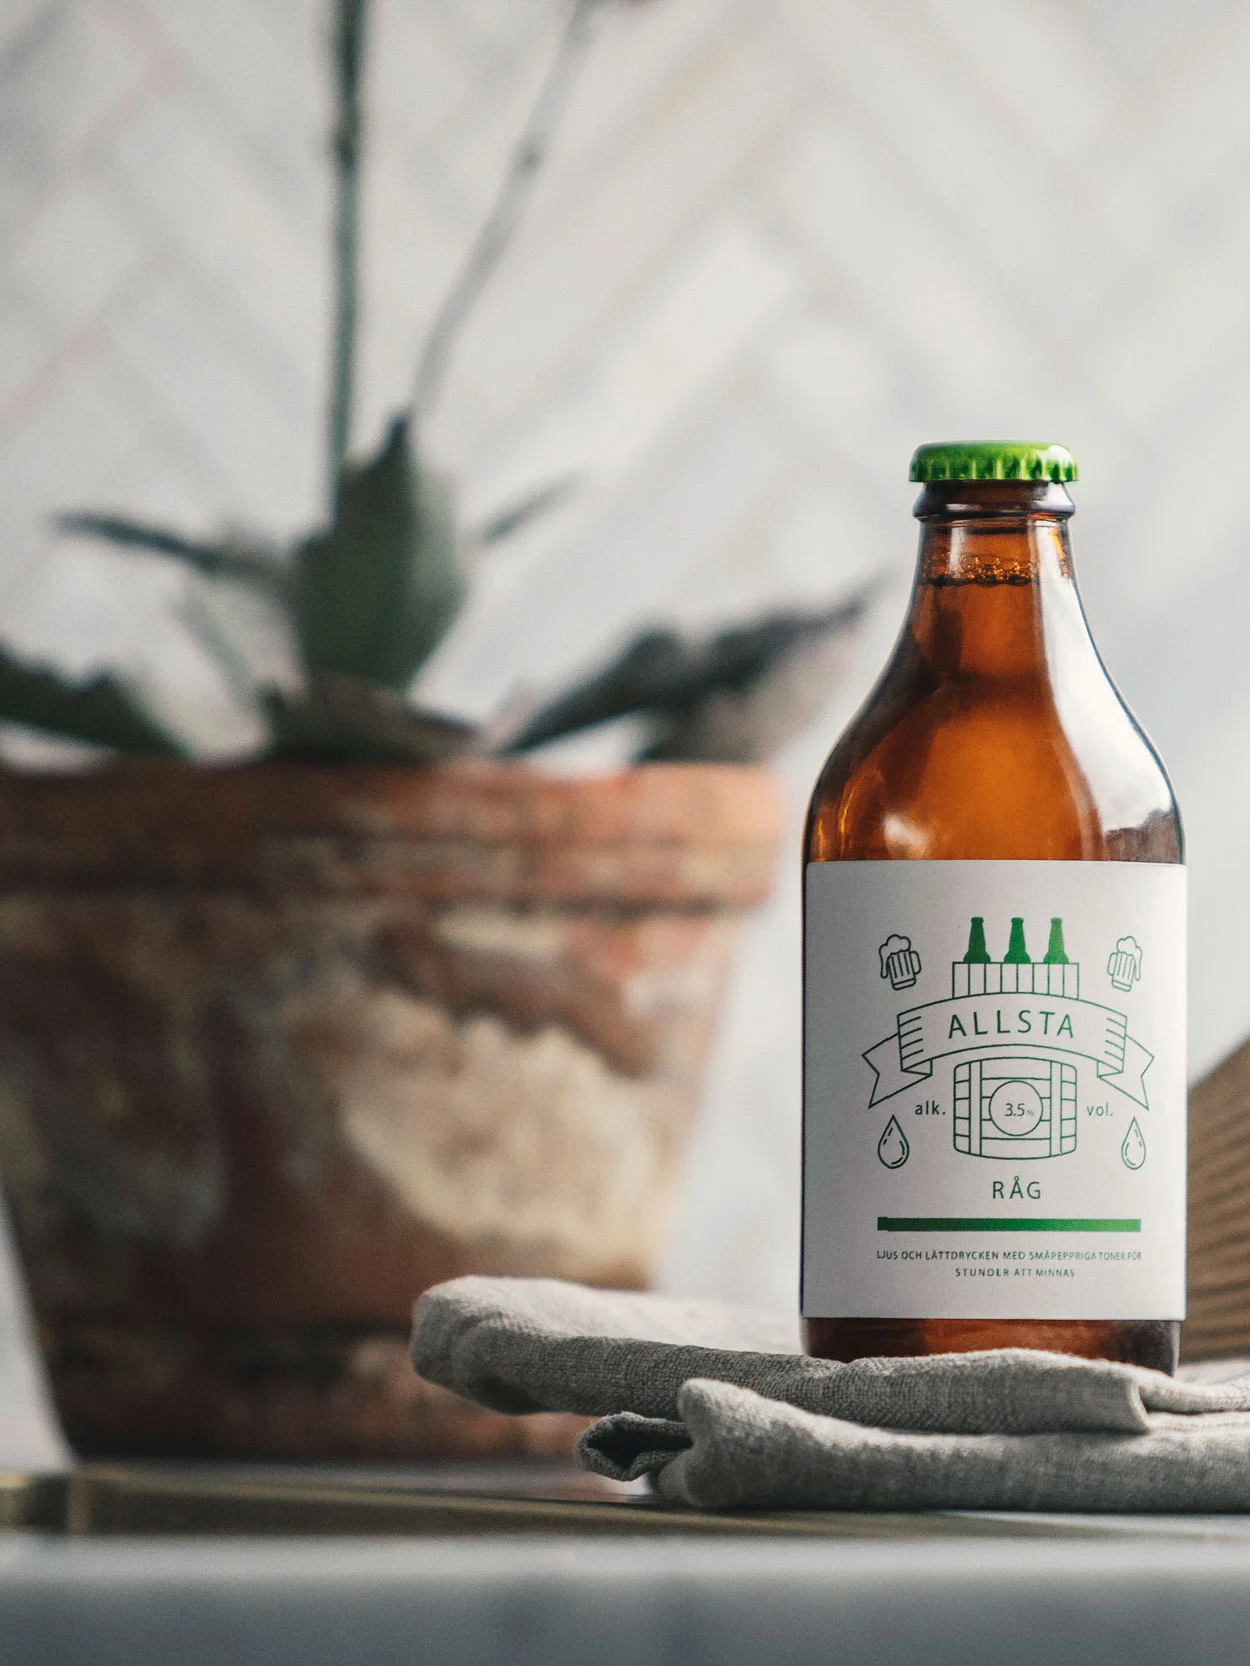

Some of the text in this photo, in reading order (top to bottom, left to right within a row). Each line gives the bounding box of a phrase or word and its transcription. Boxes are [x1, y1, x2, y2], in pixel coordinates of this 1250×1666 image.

[948, 1009, 1074, 1039] ALLSTA
[914, 1100, 946, 1116] alk.
[1086, 1102, 1114, 1117] vol.
[992, 1175, 1042, 1200] RÅG
[901, 1250, 922, 1260] OCH
[925, 1249, 999, 1260] LÄTTDRYCKEN
[1002, 1250, 1026, 1260] MED
[1029, 1249, 1097, 1260] SMÅPEPPRIGA
[1098, 1251, 1126, 1261] TONER
[1127, 1250, 1142, 1260] FÖR
[955, 1267, 1075, 1277] STUNDER ATT MINNAS
